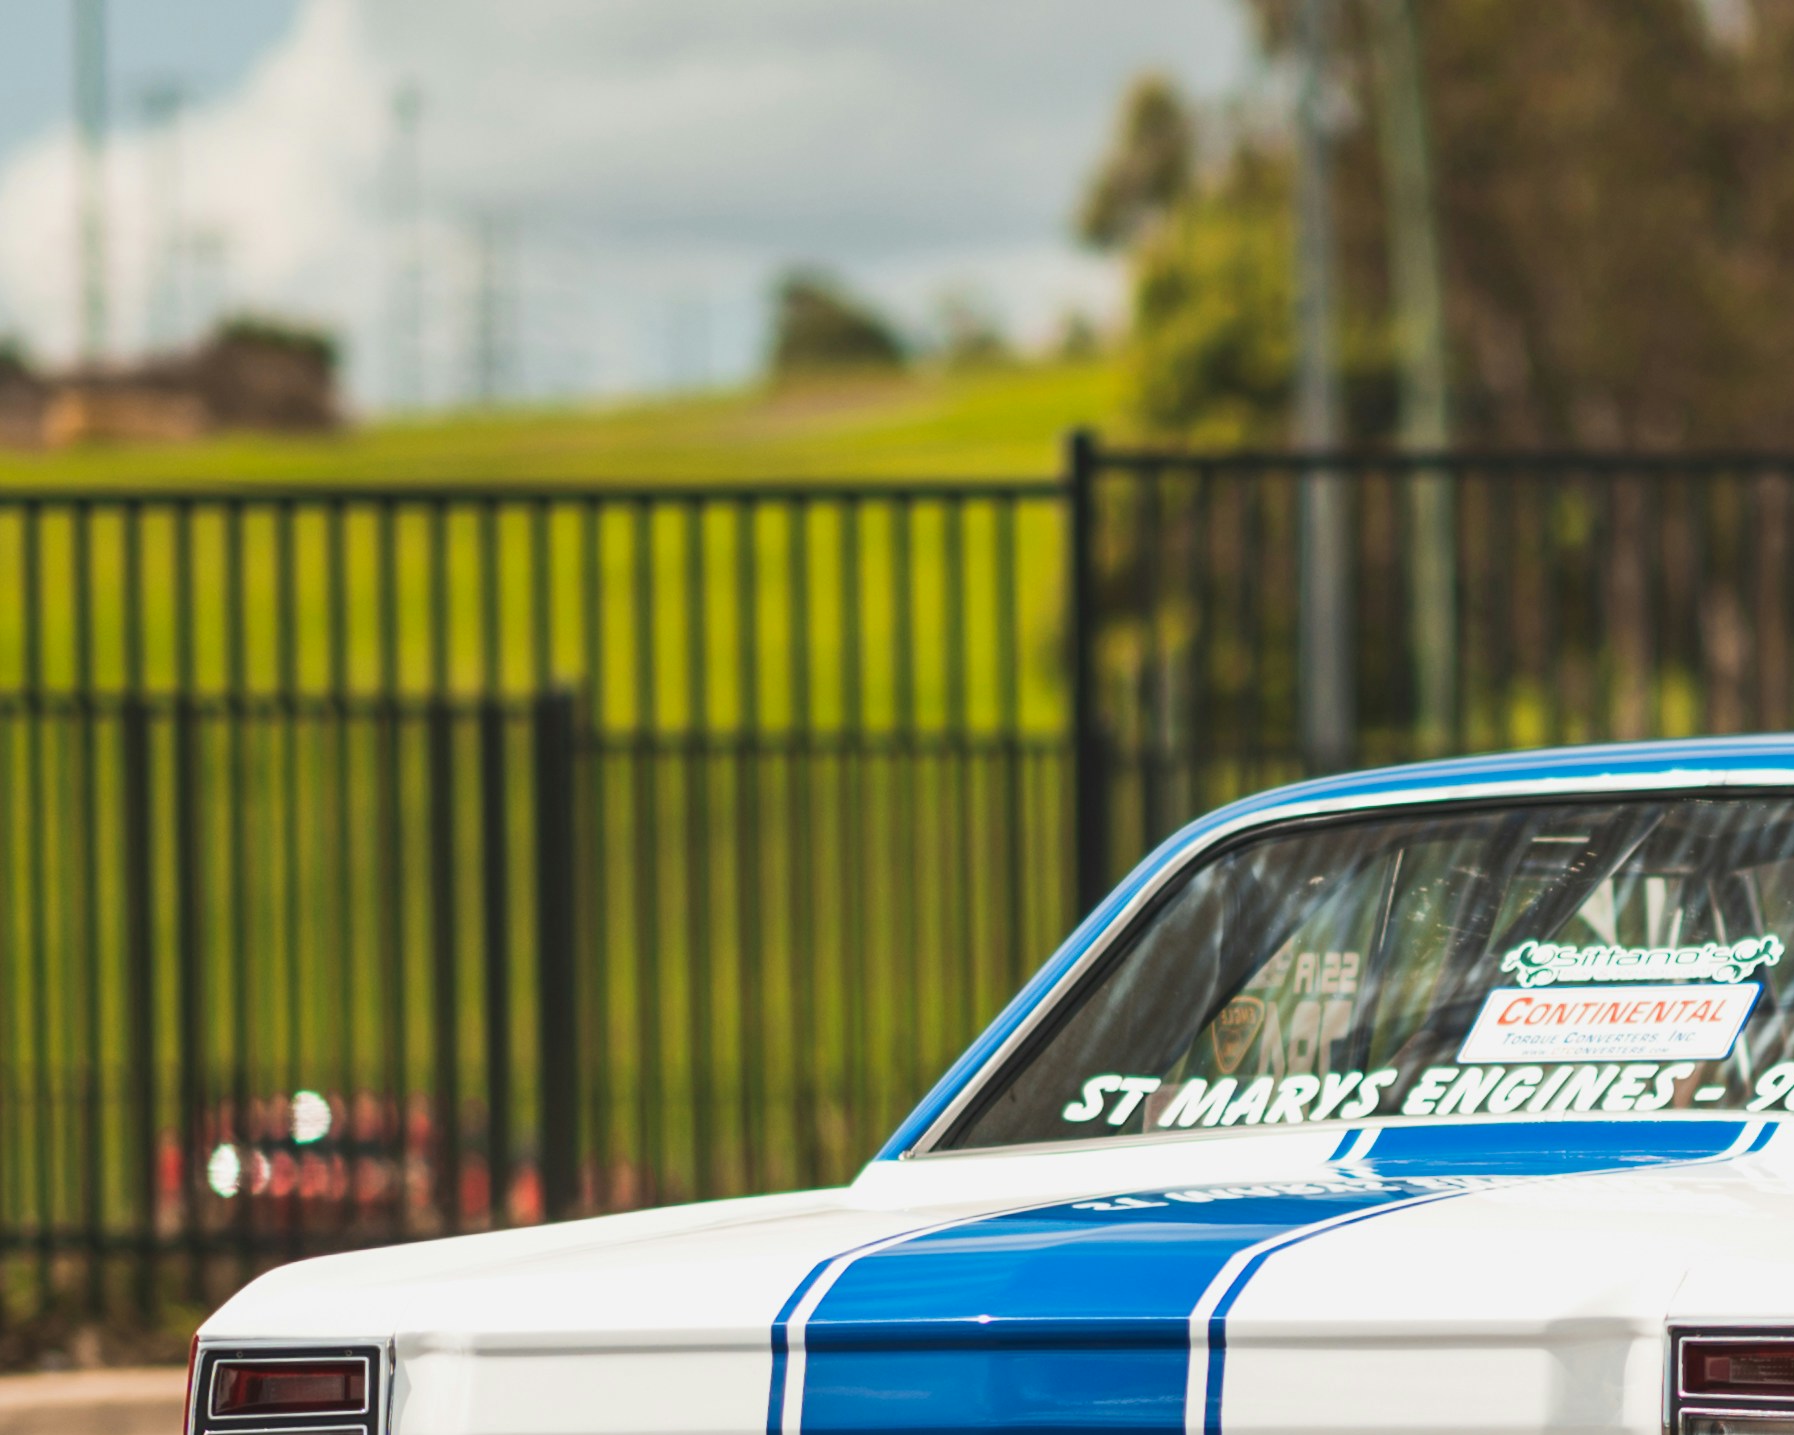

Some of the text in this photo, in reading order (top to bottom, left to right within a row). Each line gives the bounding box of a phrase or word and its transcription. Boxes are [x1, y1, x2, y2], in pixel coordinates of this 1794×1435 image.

[1497, 997, 1727, 1026] CONTINENTAL
[1063, 1074, 1162, 1126] ST
[1157, 1069, 1398, 1128] MARYS
[1401, 1062, 1697, 1116] ENGINES
[1693, 1086, 1727, 1101] -
